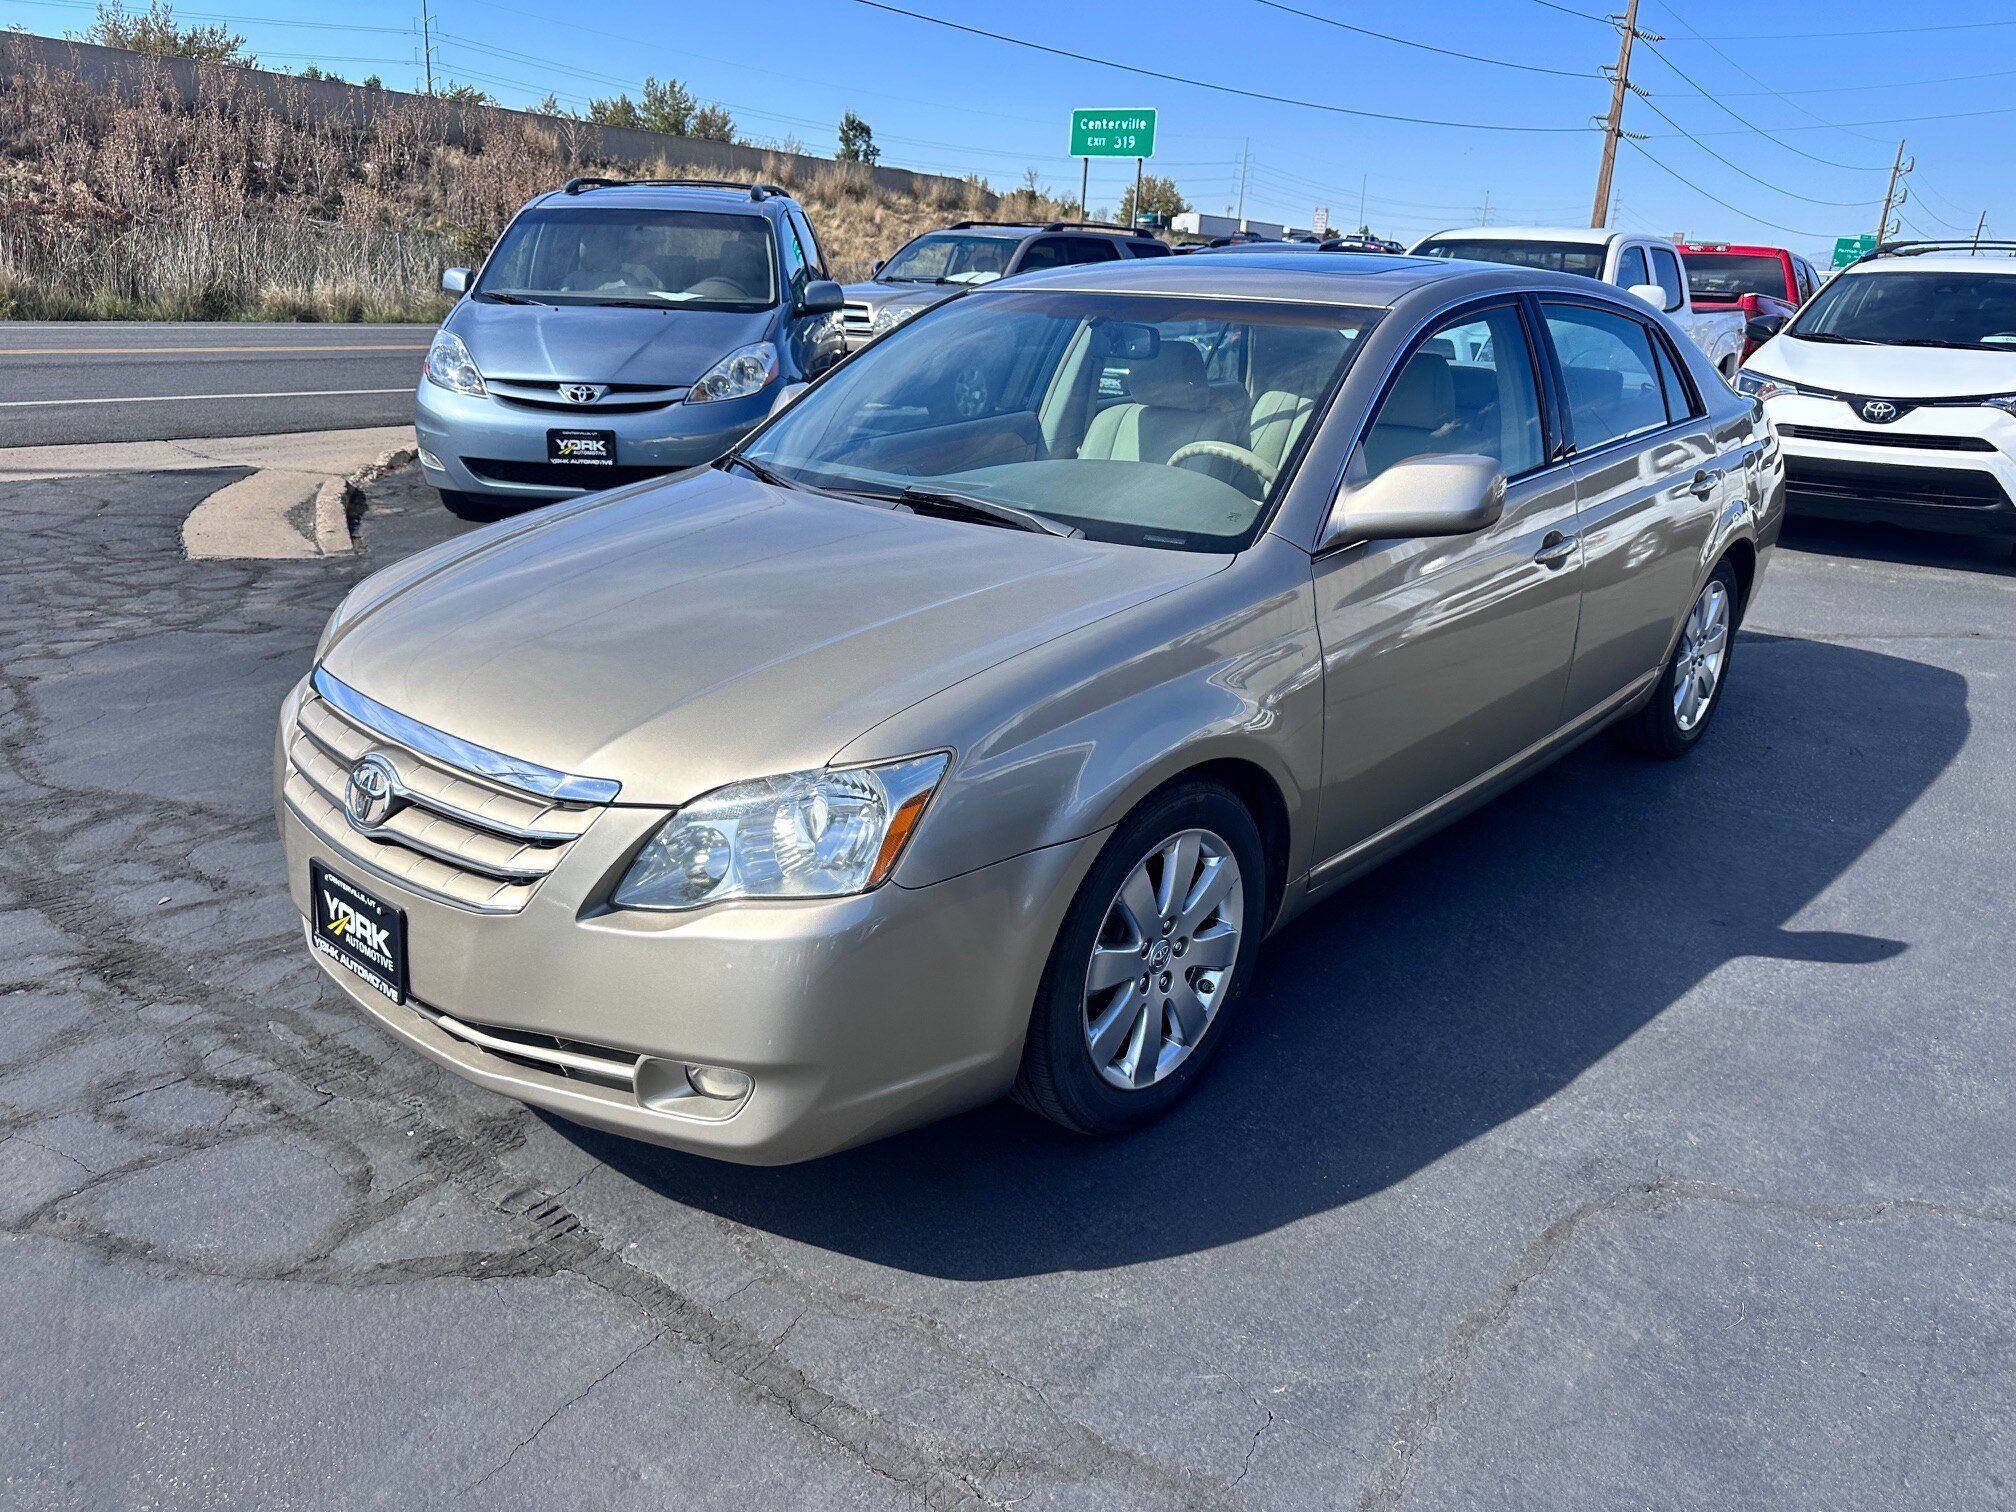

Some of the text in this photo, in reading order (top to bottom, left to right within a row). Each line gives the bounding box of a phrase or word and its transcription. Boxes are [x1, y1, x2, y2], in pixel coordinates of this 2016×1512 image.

[1080, 118, 1147, 130] Centerville
[1087, 136, 1135, 149] EXIT 319
[556, 439, 606, 451] YORK
[323, 889, 393, 959] YORK
[345, 933, 394, 972] AUTOMOTIVE
[340, 953, 399, 1003] AUTOMOTIVE
